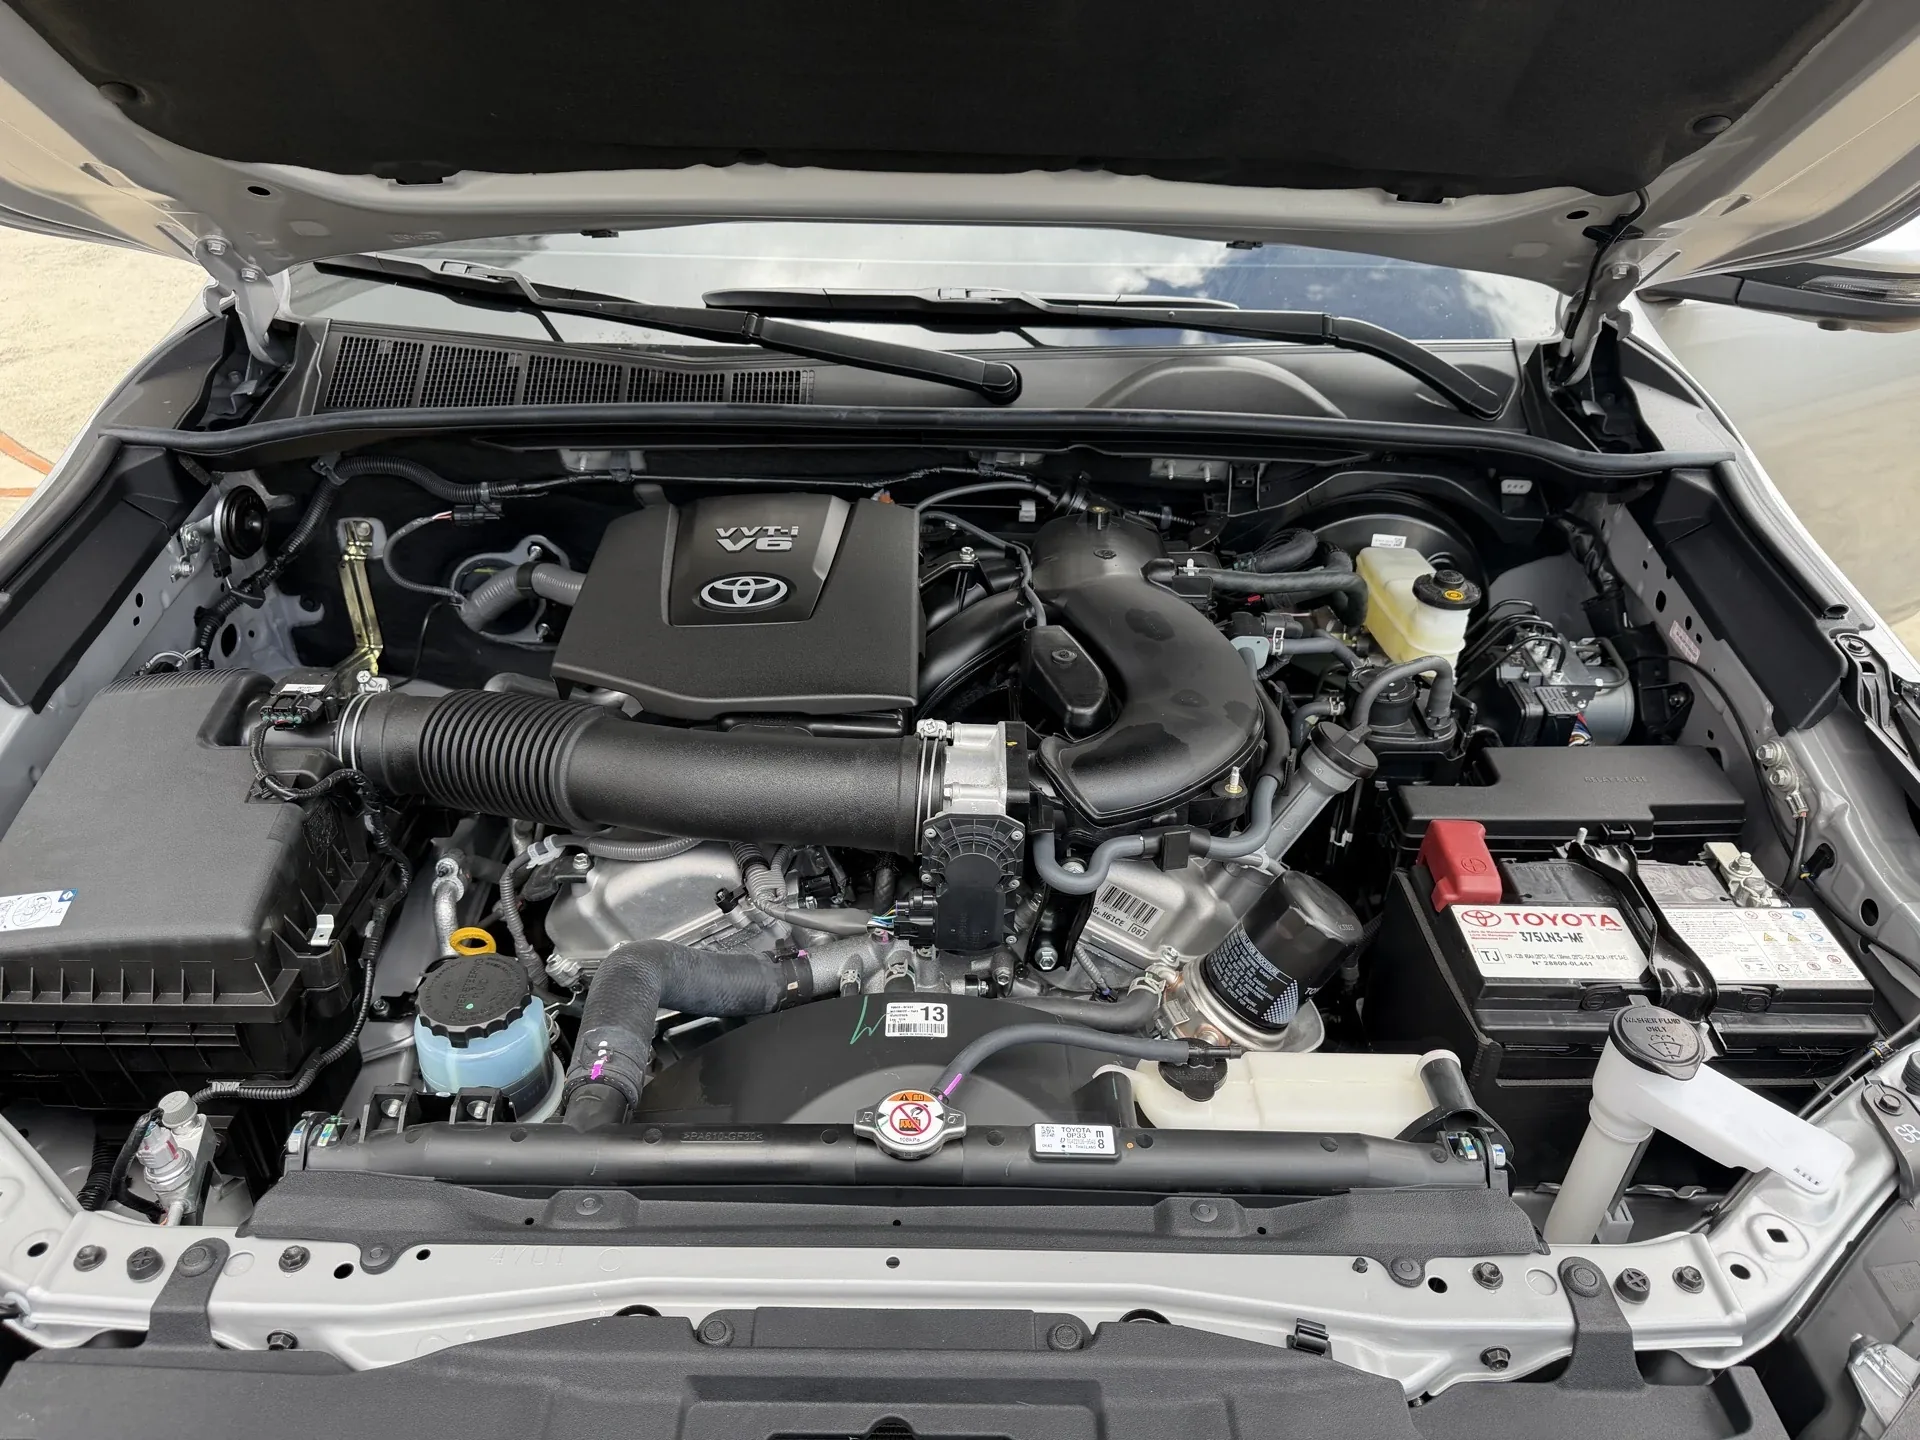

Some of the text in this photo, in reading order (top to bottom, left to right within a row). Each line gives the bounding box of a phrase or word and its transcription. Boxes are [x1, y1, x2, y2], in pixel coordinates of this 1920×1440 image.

[716, 526, 799, 538] VVT-i
[716, 537, 793, 553] V6
[1504, 912, 1621, 927] TOYOTA
[1130, 926, 1147, 938] 087
[1518, 931, 1586, 943] 375LN3-MF
[1481, 950, 1500, 962] TJ
[1253, 952, 1279, 975] PROCEDURE
[1258, 968, 1273, 981] GASKET
[1252, 976, 1267, 989] GASKET
[920, 1006, 945, 1021] 13
[1623, 1016, 1681, 1024] WASHER FLUID
[1097, 1138, 1105, 1149] 8
